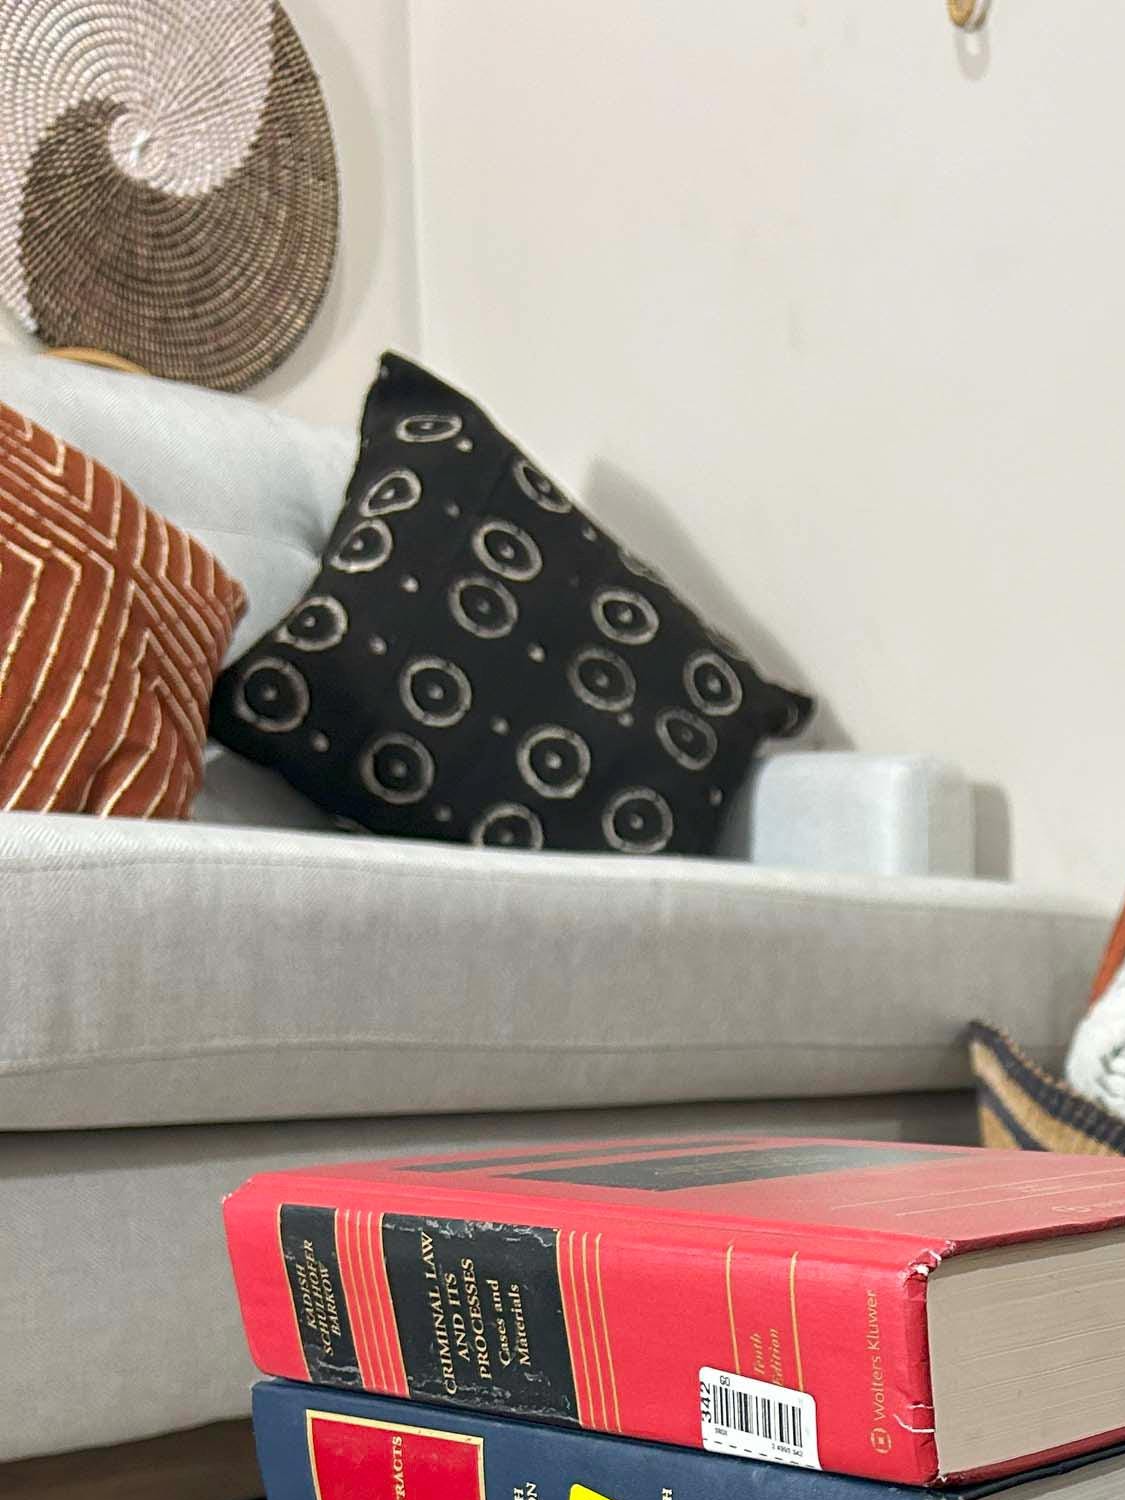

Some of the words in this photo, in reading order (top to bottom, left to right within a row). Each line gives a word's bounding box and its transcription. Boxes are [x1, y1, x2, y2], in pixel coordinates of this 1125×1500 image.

[421, 1231, 437, 1280] LAW
[295, 1263, 318, 1330] KADISH
[303, 1239, 334, 1357] SCHULHOFER
[319, 1262, 342, 1337] BARKOW
[444, 1272, 462, 1307] ITS
[460, 1258, 492, 1380] PROCESSES
[486, 1279, 503, 1312] and
[865, 1289, 881, 1351] Kluwer
[428, 1285, 458, 1395] CRIMINAL
[452, 1313, 471, 1362] AND
[497, 1318, 512, 1368] Cases
[508, 1283, 531, 1367] Materials
[871, 1355, 887, 1421] Wolters
